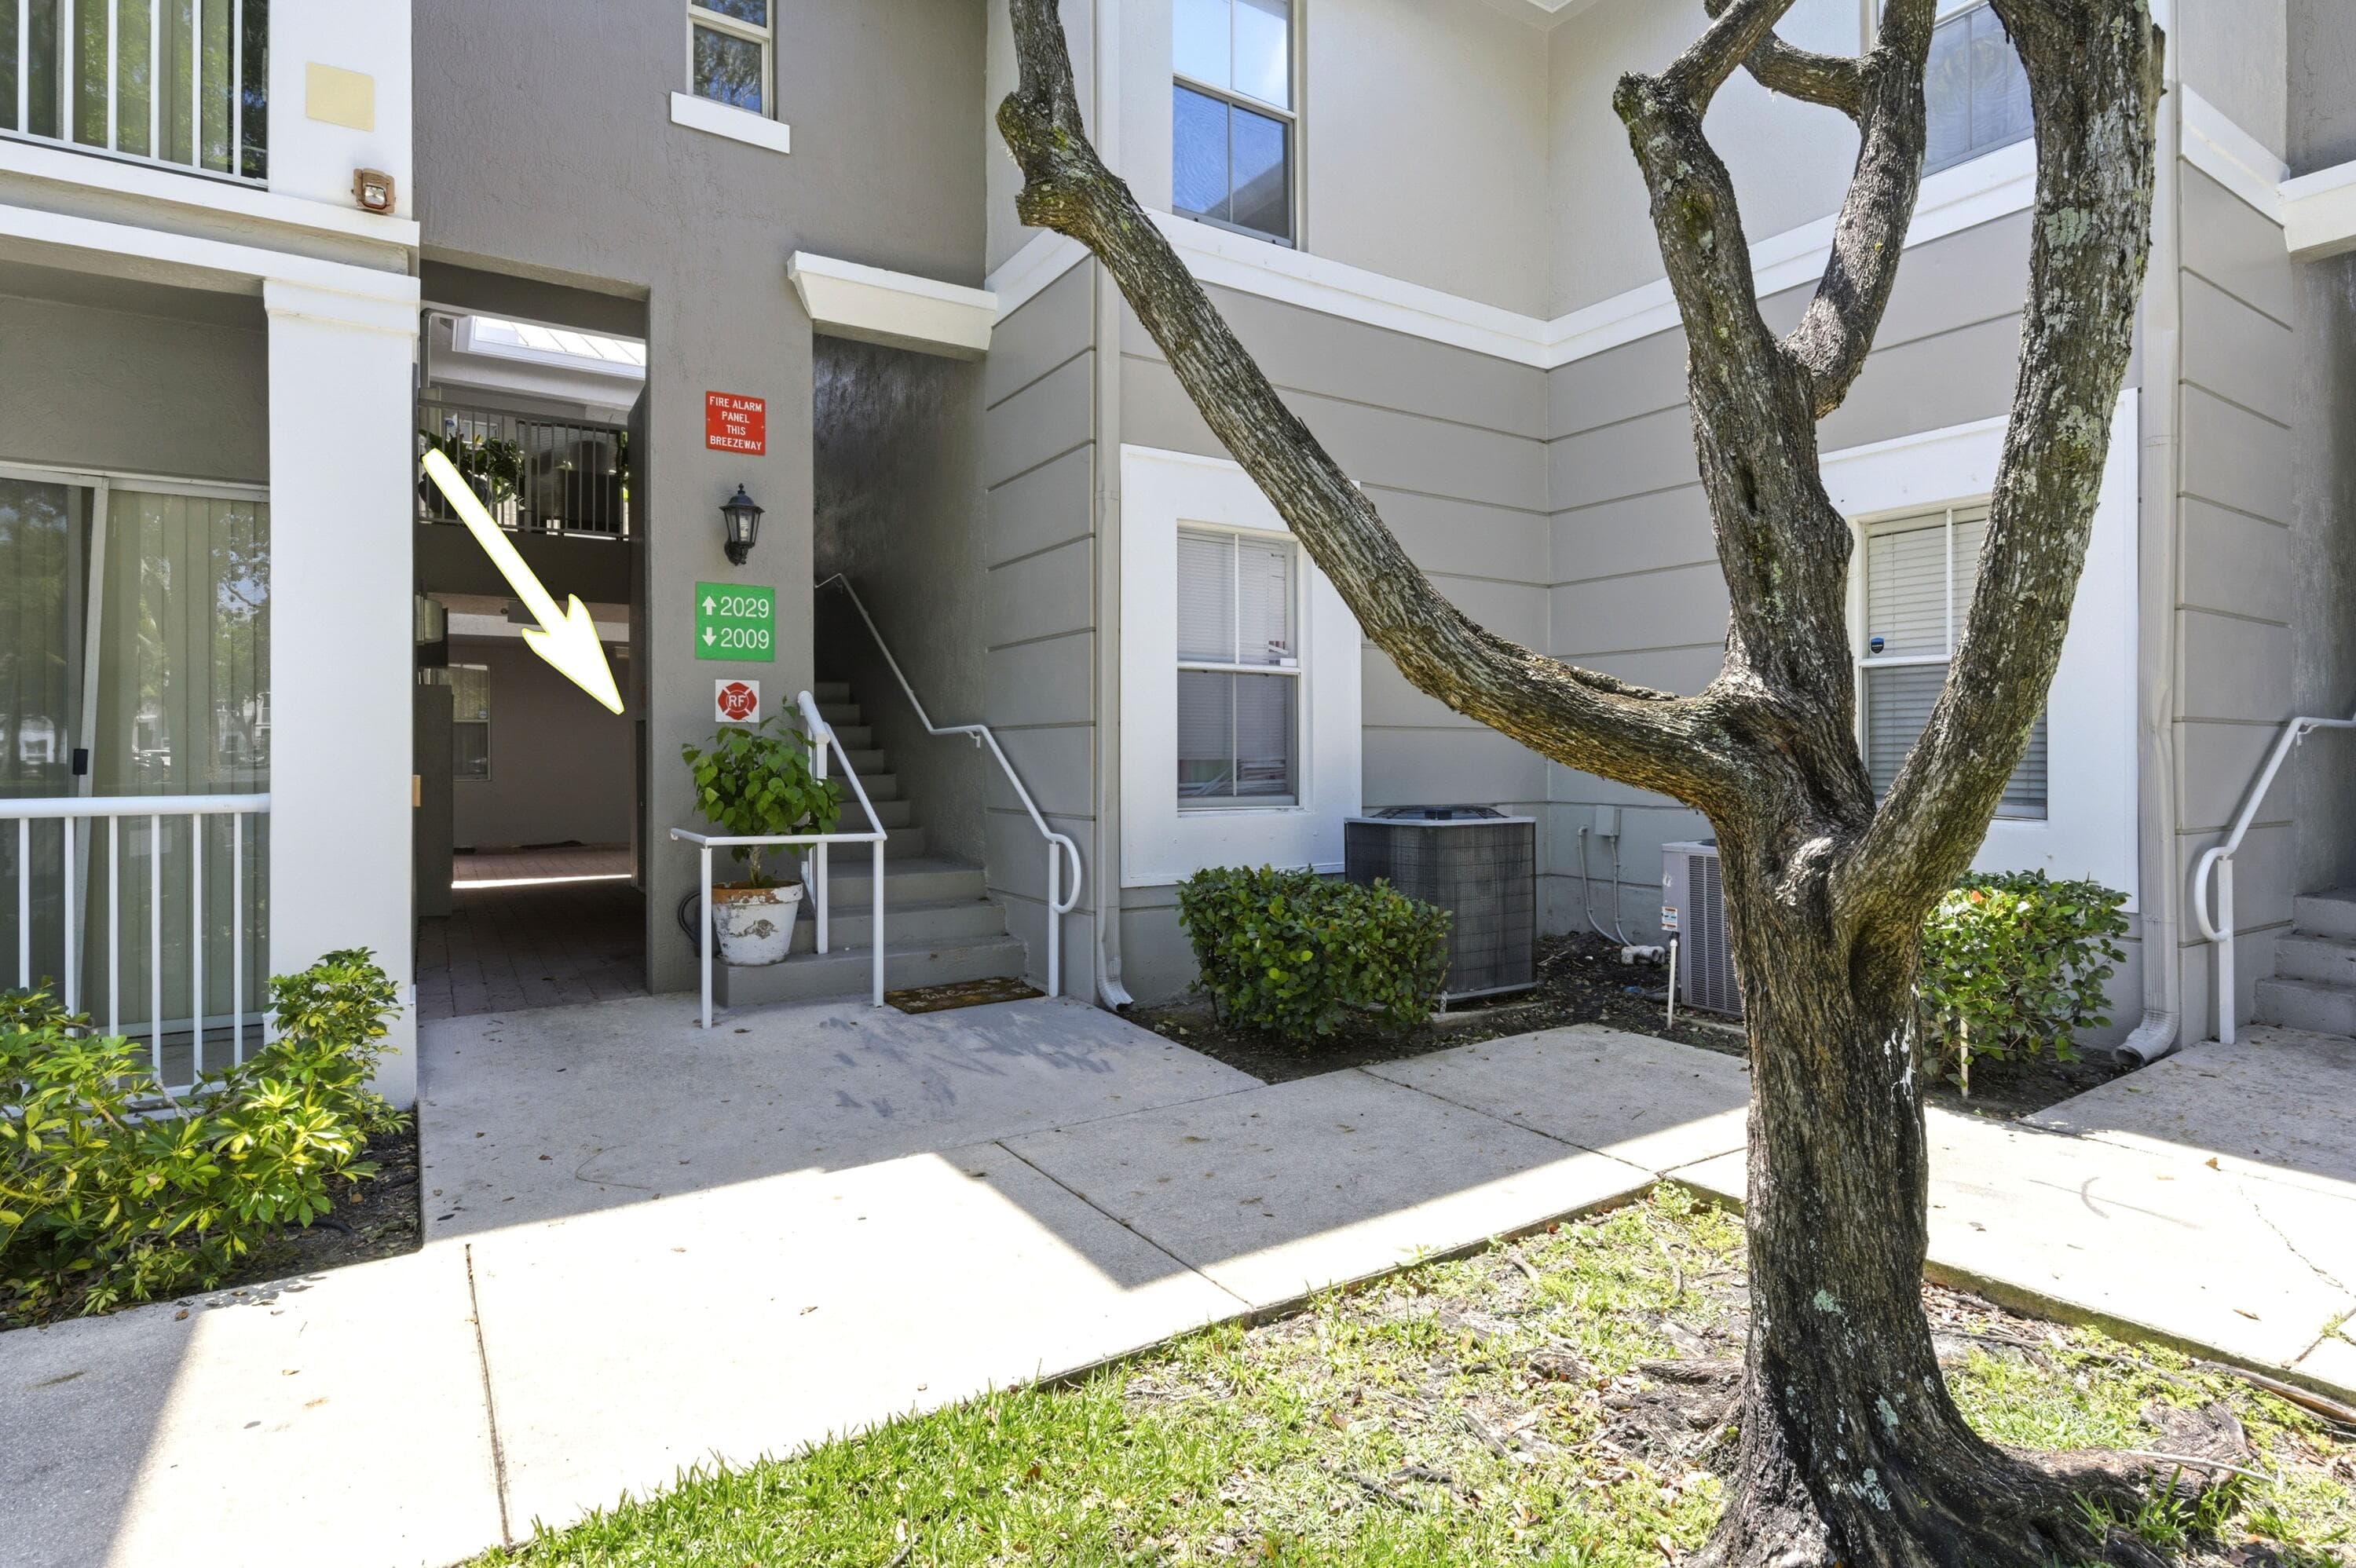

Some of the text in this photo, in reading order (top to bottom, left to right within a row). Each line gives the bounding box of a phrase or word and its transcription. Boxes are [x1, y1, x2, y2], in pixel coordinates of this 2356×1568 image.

[709, 396, 762, 412] FIRE ALARM
[722, 411, 750, 423] PANEL
[726, 425, 746, 436] THIS
[710, 435, 762, 451] BREEZEWAY
[720, 596, 770, 619] 2029
[720, 627, 770, 649] 2009
[728, 695, 746, 707] RF
